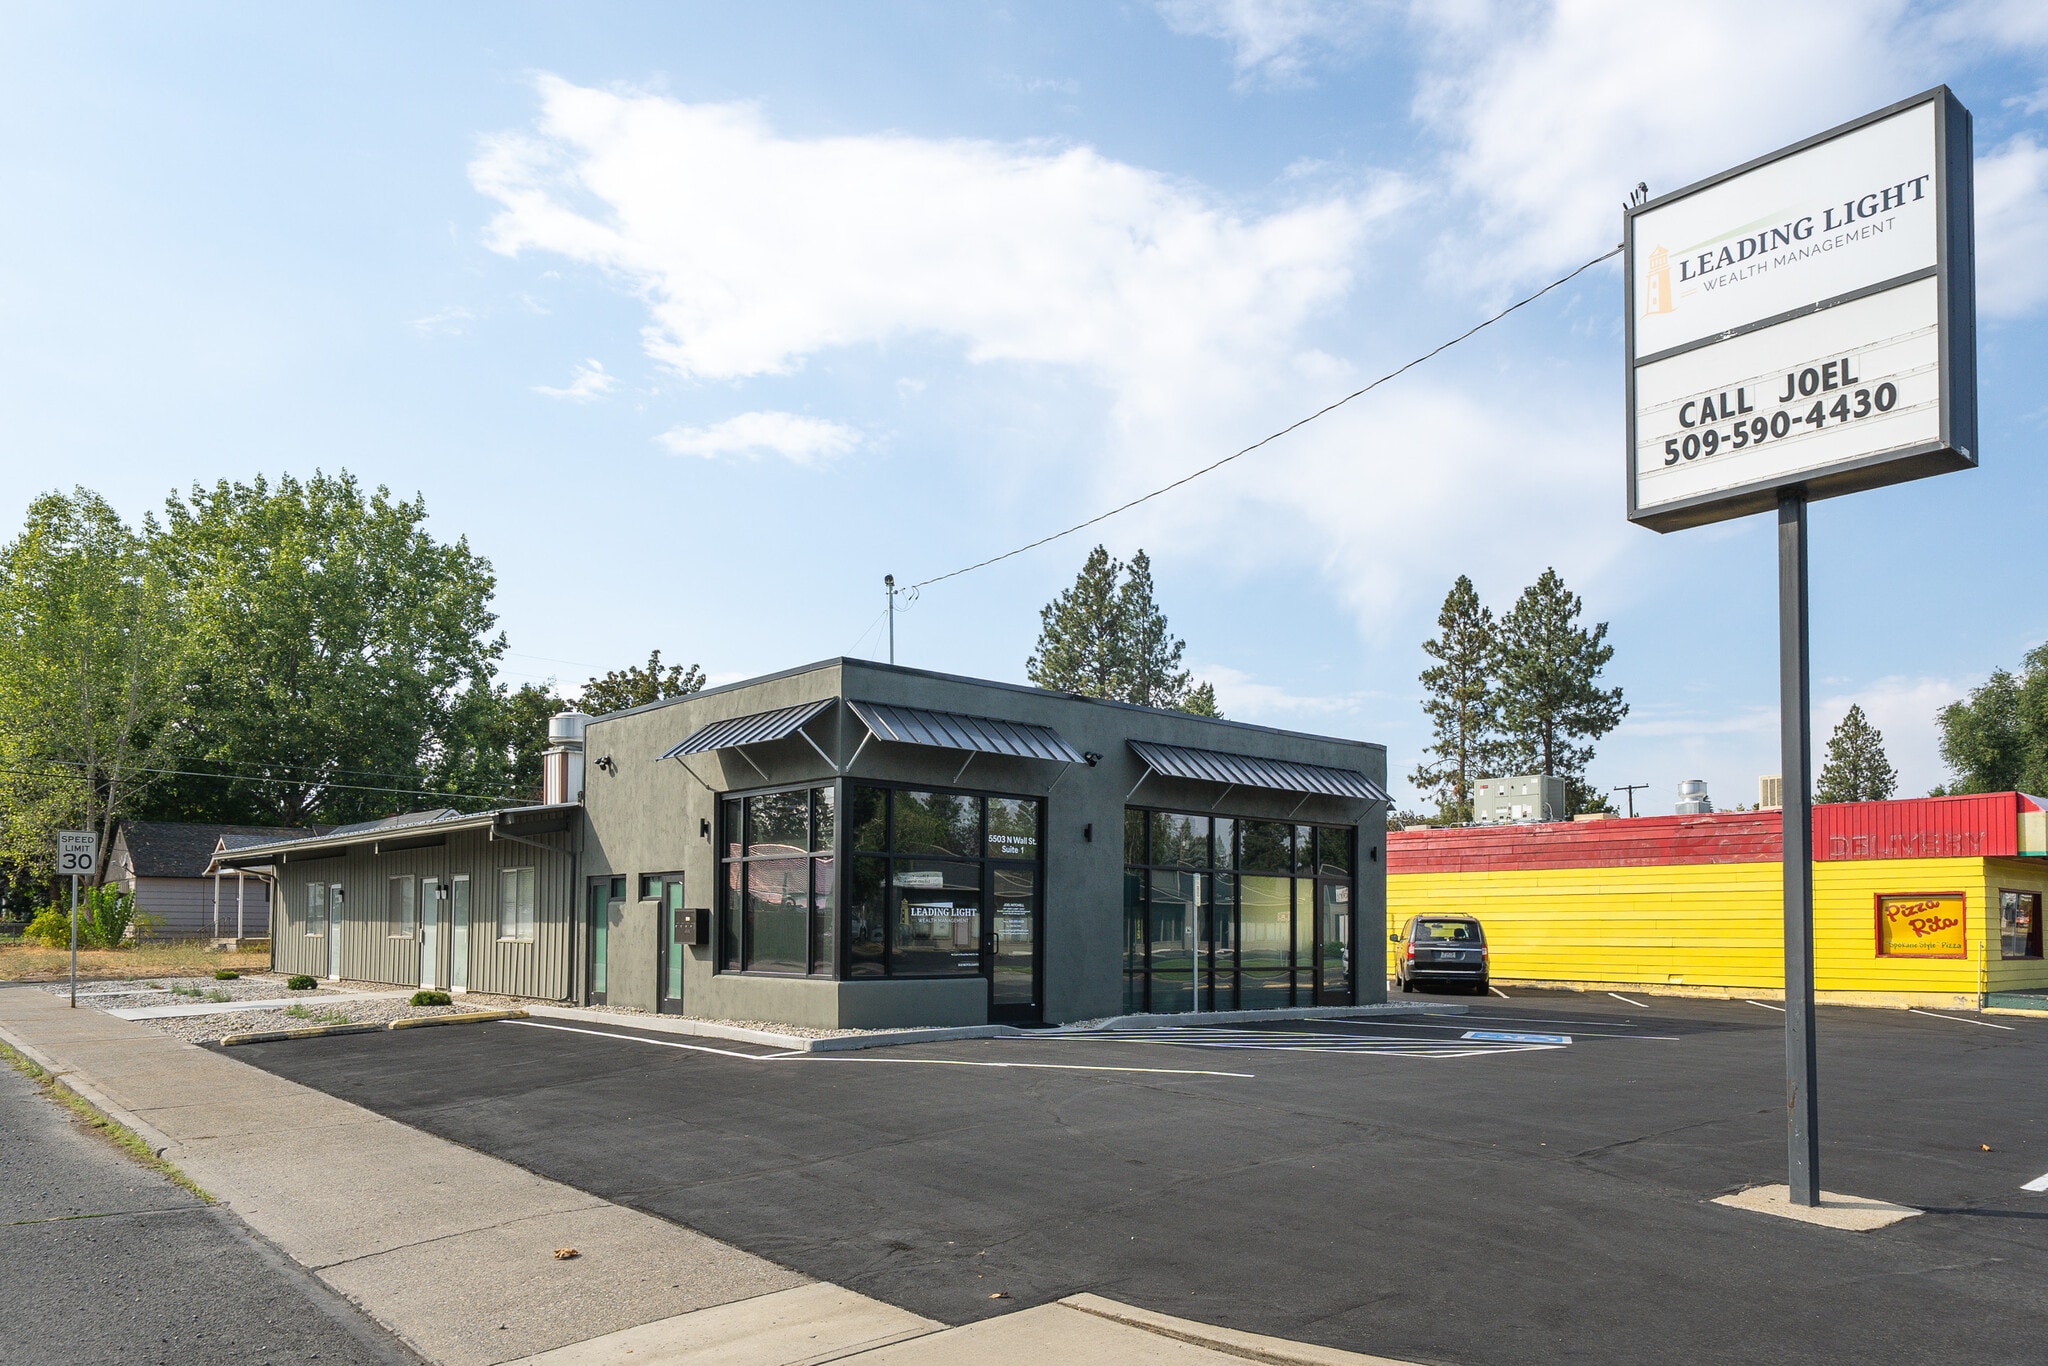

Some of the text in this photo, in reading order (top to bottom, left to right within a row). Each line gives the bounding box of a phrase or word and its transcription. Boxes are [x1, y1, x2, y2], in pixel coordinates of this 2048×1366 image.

[1679, 174, 1930, 283] LEADING LIGHT
[1703, 217, 1897, 292] WEALTH MANAGEMENT
[1679, 358, 1859, 428] CALL JOEL
[1664, 382, 1898, 466] 509-590-4430
[61, 835, 95, 844] SPEED
[988, 834, 1006, 843] 5503
[1006, 835, 1013, 844] N
[1013, 836, 1028, 845] Wall
[1001, 845, 1025, 854] Suite 1
[62, 853, 93, 870] 30
[911, 907, 977, 917] LEADING LIGHT
[1886, 900, 1940, 922] Pizza
[1908, 916, 1959, 938] Rita
[1941, 941, 1962, 949] Pizza
